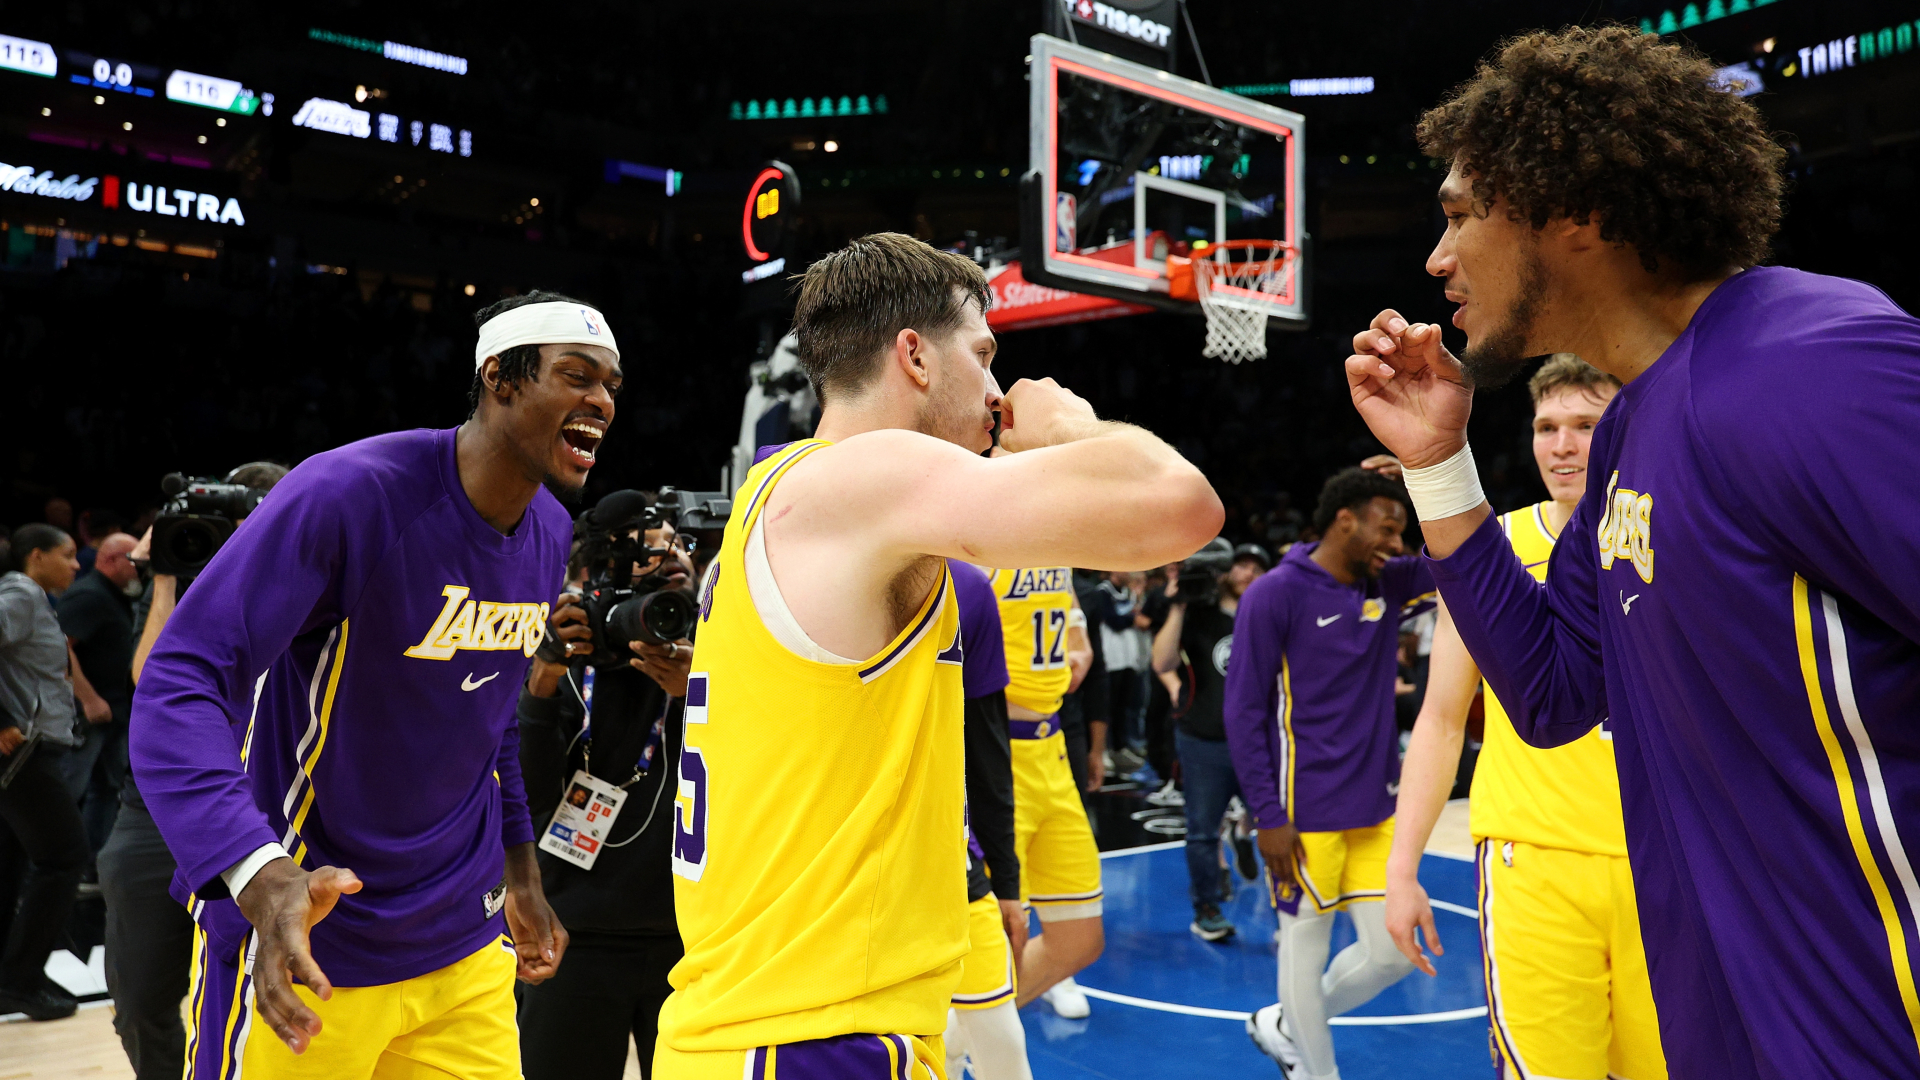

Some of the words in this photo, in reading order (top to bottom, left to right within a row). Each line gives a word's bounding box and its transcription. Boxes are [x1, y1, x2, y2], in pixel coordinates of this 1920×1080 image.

[1093, 1, 1171, 47] TISSOT
[93, 58, 133, 87] 0.0
[127, 181, 246, 227] ULTRA
[403, 584, 550, 661] LAKERS
[1031, 608, 1066, 671] 12
